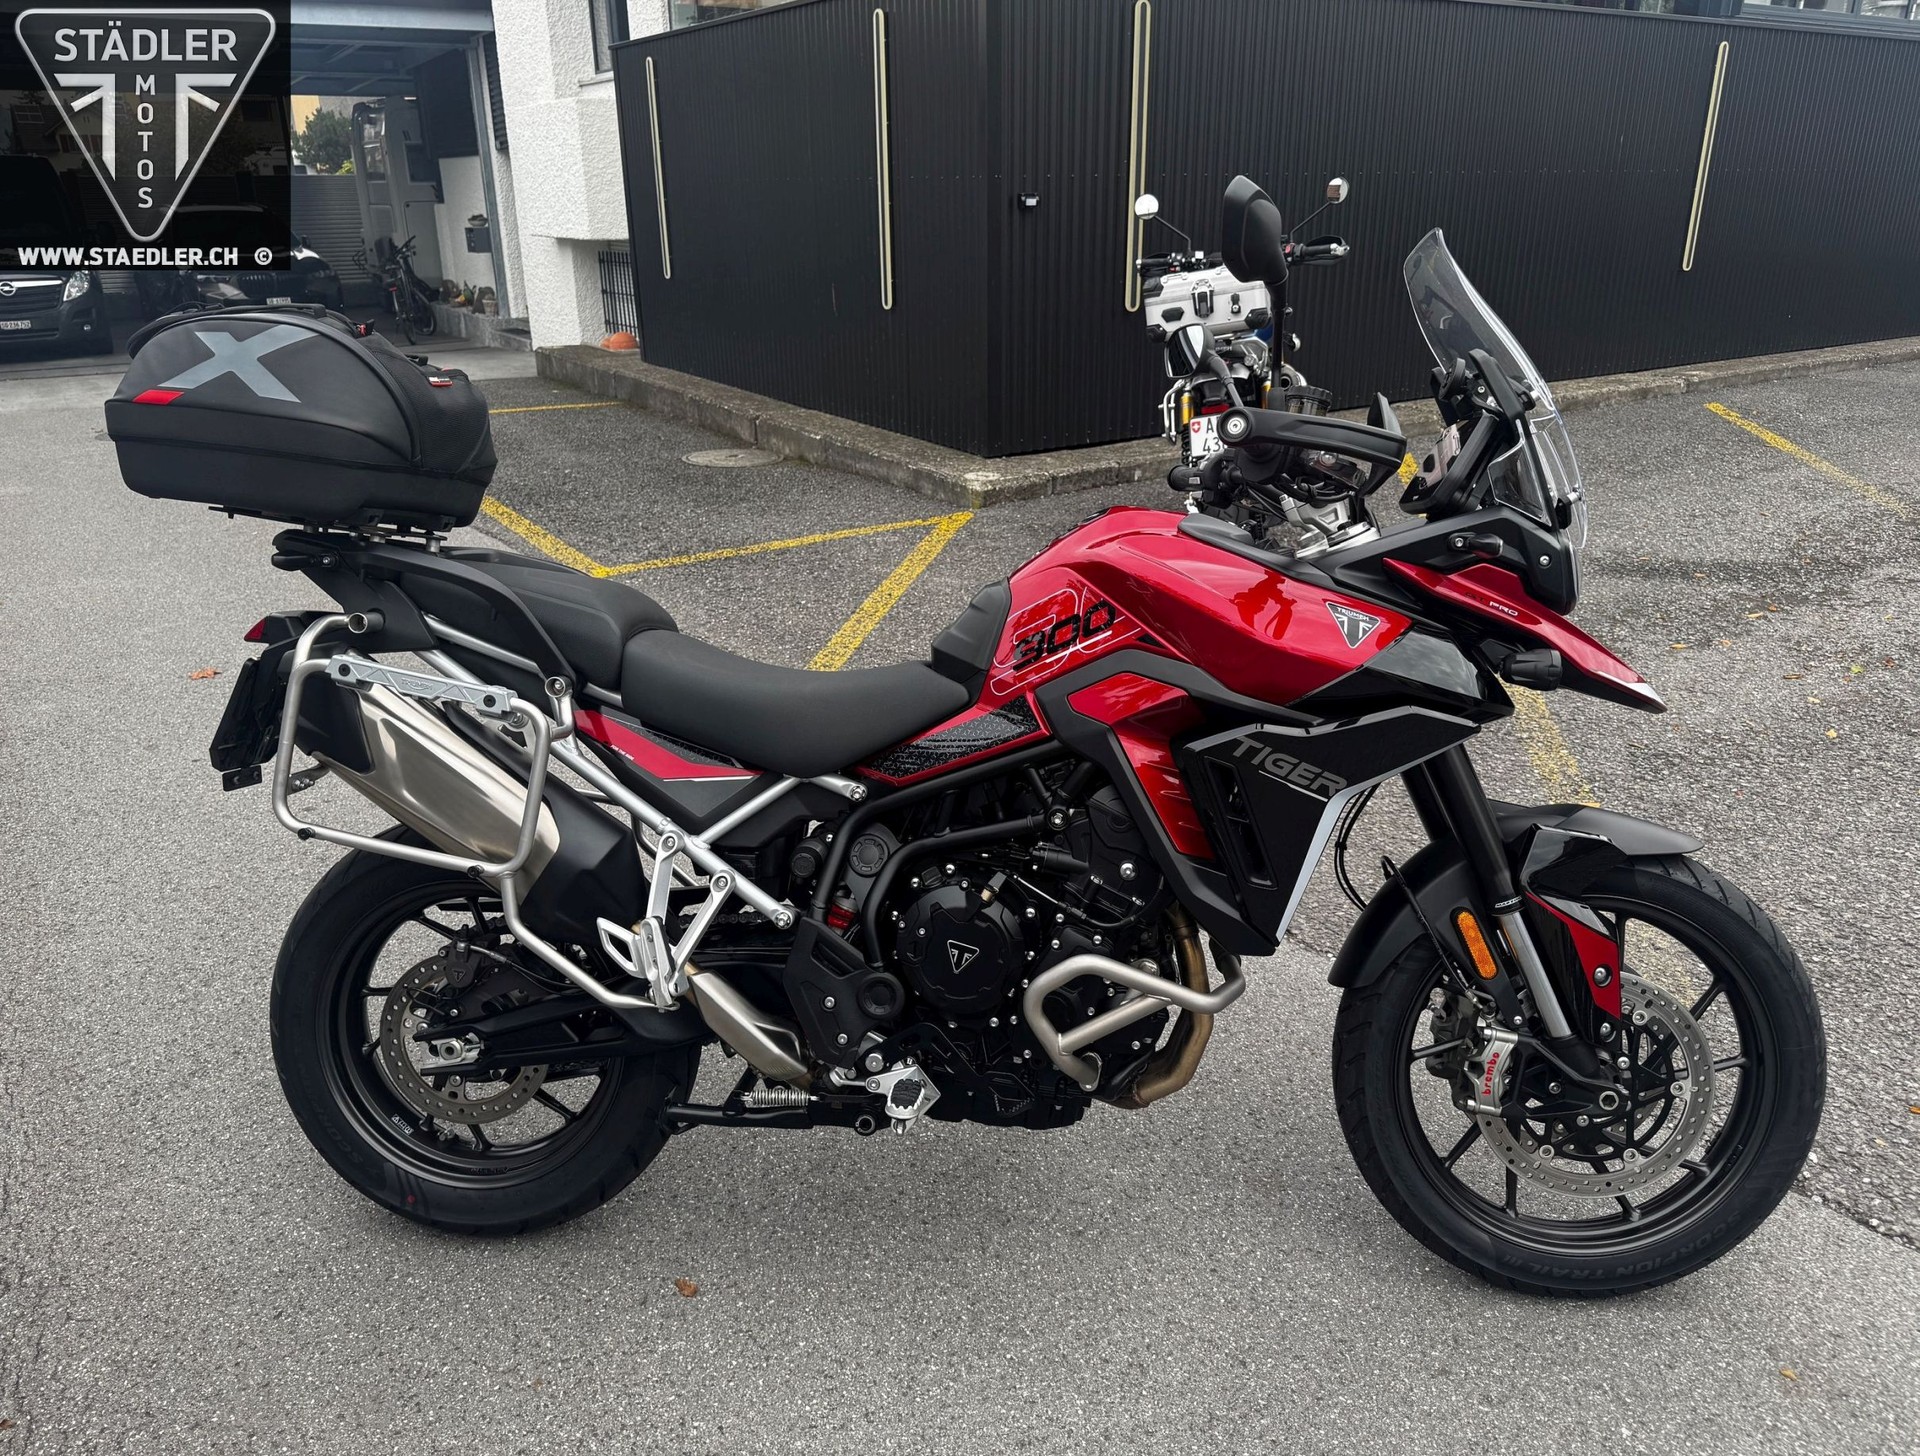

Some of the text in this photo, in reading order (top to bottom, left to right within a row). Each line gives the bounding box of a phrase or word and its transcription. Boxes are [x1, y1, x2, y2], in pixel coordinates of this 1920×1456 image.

[1336, 606, 1369, 621] TRIUMPH
[1489, 601, 1518, 616] PRO
[1232, 735, 1348, 797] TIGER
[1481, 1052, 1500, 1096] brembo
[1528, 1261, 1605, 1280] TRAIL
